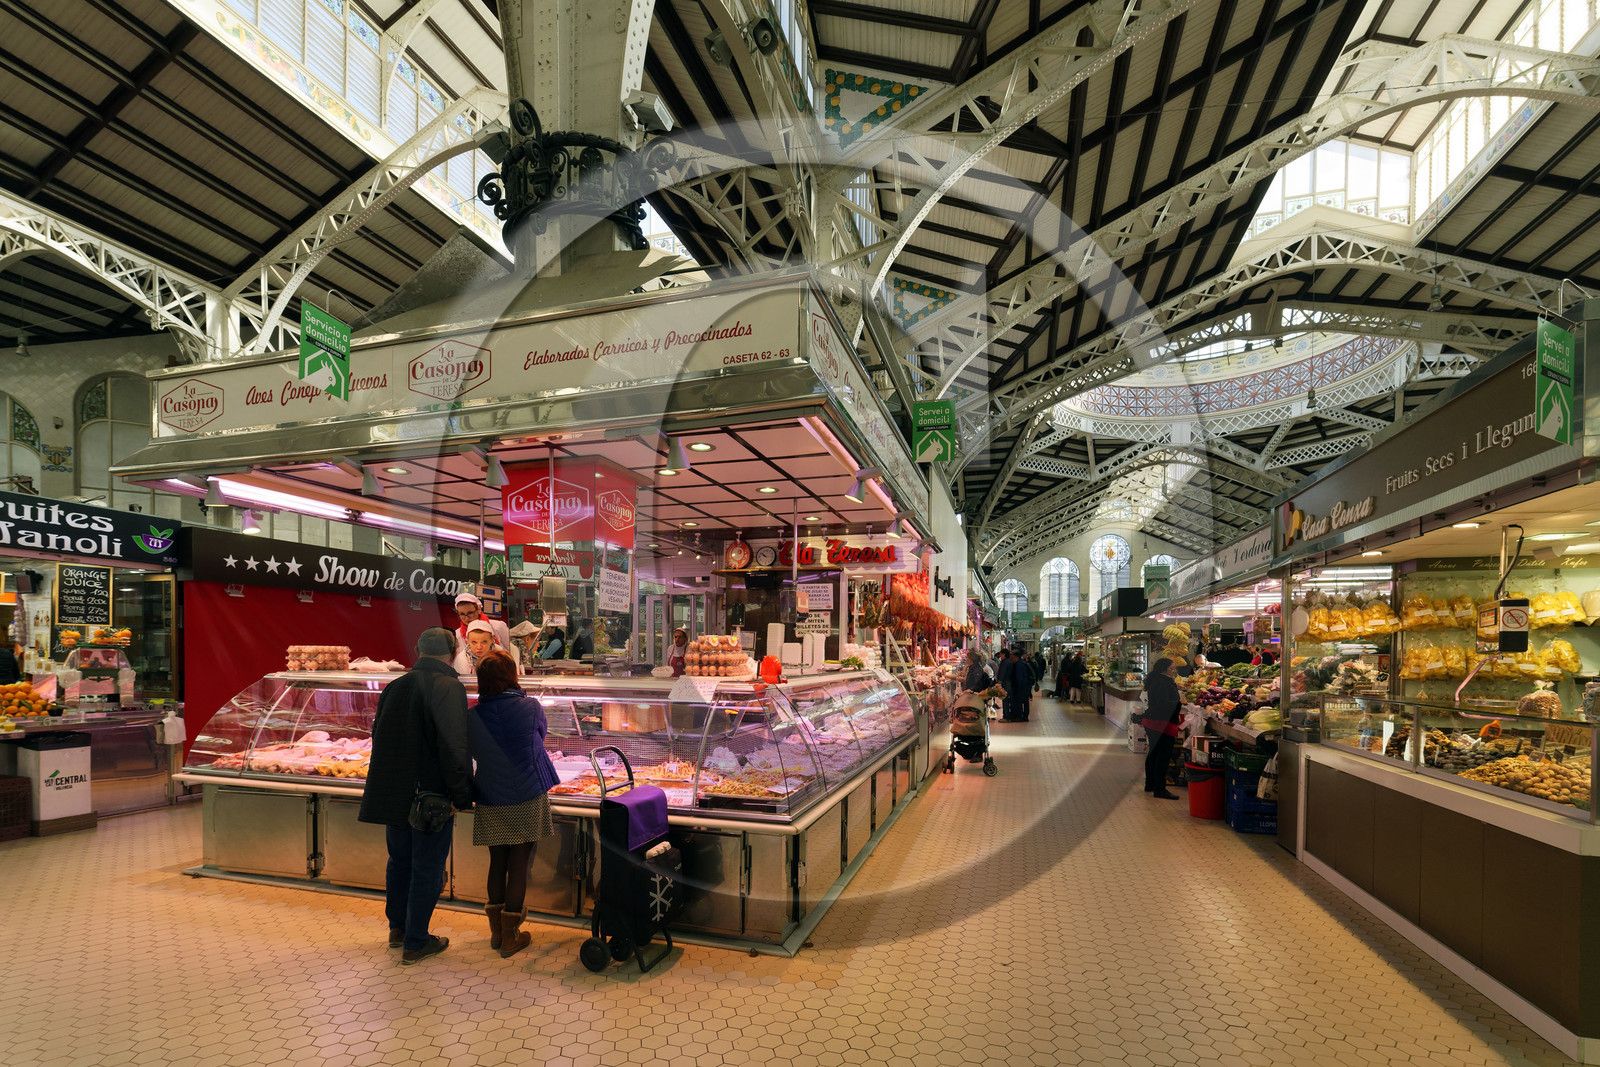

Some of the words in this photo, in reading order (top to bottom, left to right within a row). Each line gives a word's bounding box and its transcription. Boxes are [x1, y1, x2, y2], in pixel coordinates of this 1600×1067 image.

[305, 310, 341, 338] Servicio
[342, 334, 348, 342] a
[305, 324, 347, 353] domicilio
[523, 348, 590, 371] Elaborados
[593, 339, 649, 362] Carnicos
[651, 337, 661, 352] y
[664, 320, 753, 350] Precocinados
[1543, 330, 1565, 354] Servei
[1565, 347, 1570, 357] a
[438, 347, 455, 363] La
[722, 352, 759, 365] CASETA
[761, 350, 773, 361] 62
[779, 348, 790, 359] 63
[1542, 350, 1570, 374] domicili
[411, 360, 484, 382] Casona
[183, 385, 197, 400] La
[245, 386, 274, 406] Aves
[280, 380, 321, 406] Conejo
[348, 373, 388, 393] uevos
[430, 383, 465, 397] TERESA
[163, 393, 219, 416] Casona
[918, 406, 944, 416] Servei
[178, 417, 204, 428] TERESA
[918, 415, 950, 425] domicili
[1385, 468, 1421, 495] Fruits
[1425, 452, 1455, 477] Secs
[1461, 442, 1469, 460] i
[1475, 411, 1537, 453] Llegum
[511, 495, 582, 516] Casona
[600, 496, 633, 522] Casona
[0, 501, 114, 533] uites
[530, 518, 564, 531] TERESA
[608, 518, 625, 528] TERESA
[1302, 515, 1330, 541] Casa
[1330, 496, 1376, 530] Conxa
[826, 539, 898, 564] Teresa
[62, 567, 107, 582] ORANGE
[314, 555, 380, 589] Show
[383, 572, 404, 591] de
[55, 774, 88, 786] CENTRAL
